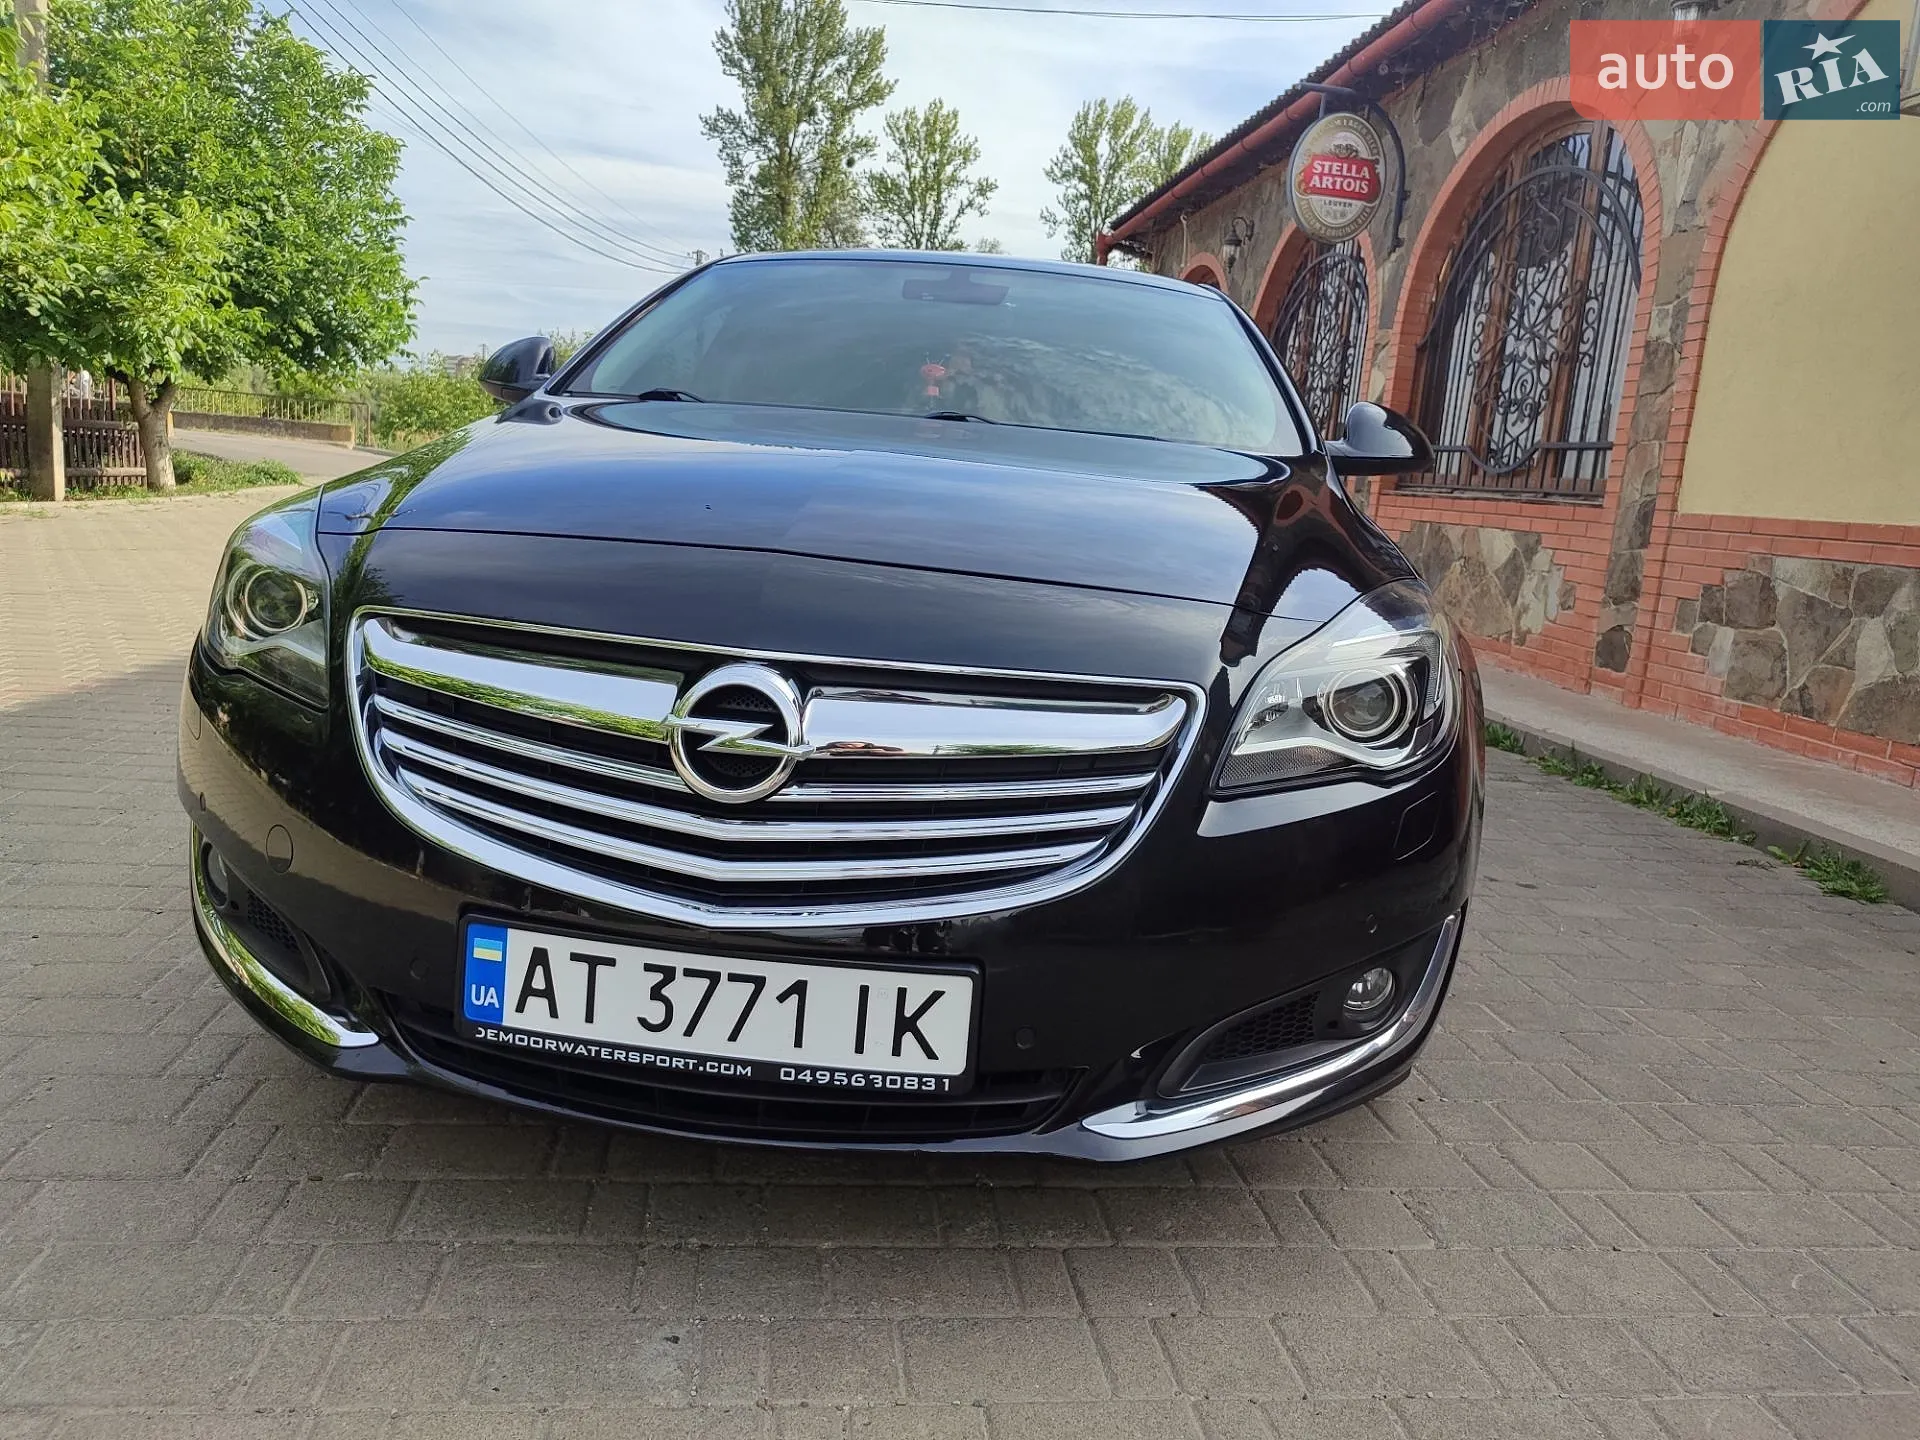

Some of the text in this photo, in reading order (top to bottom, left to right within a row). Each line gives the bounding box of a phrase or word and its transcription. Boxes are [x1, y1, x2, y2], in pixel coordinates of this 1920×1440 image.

[1312, 160, 1370, 179] STELLA
[1309, 175, 1369, 194] ARTOIS
[470, 983, 500, 1009] UA
[515, 946, 947, 1061] AT 3771 IK
[780, 1067, 950, 1092] 0495630831
